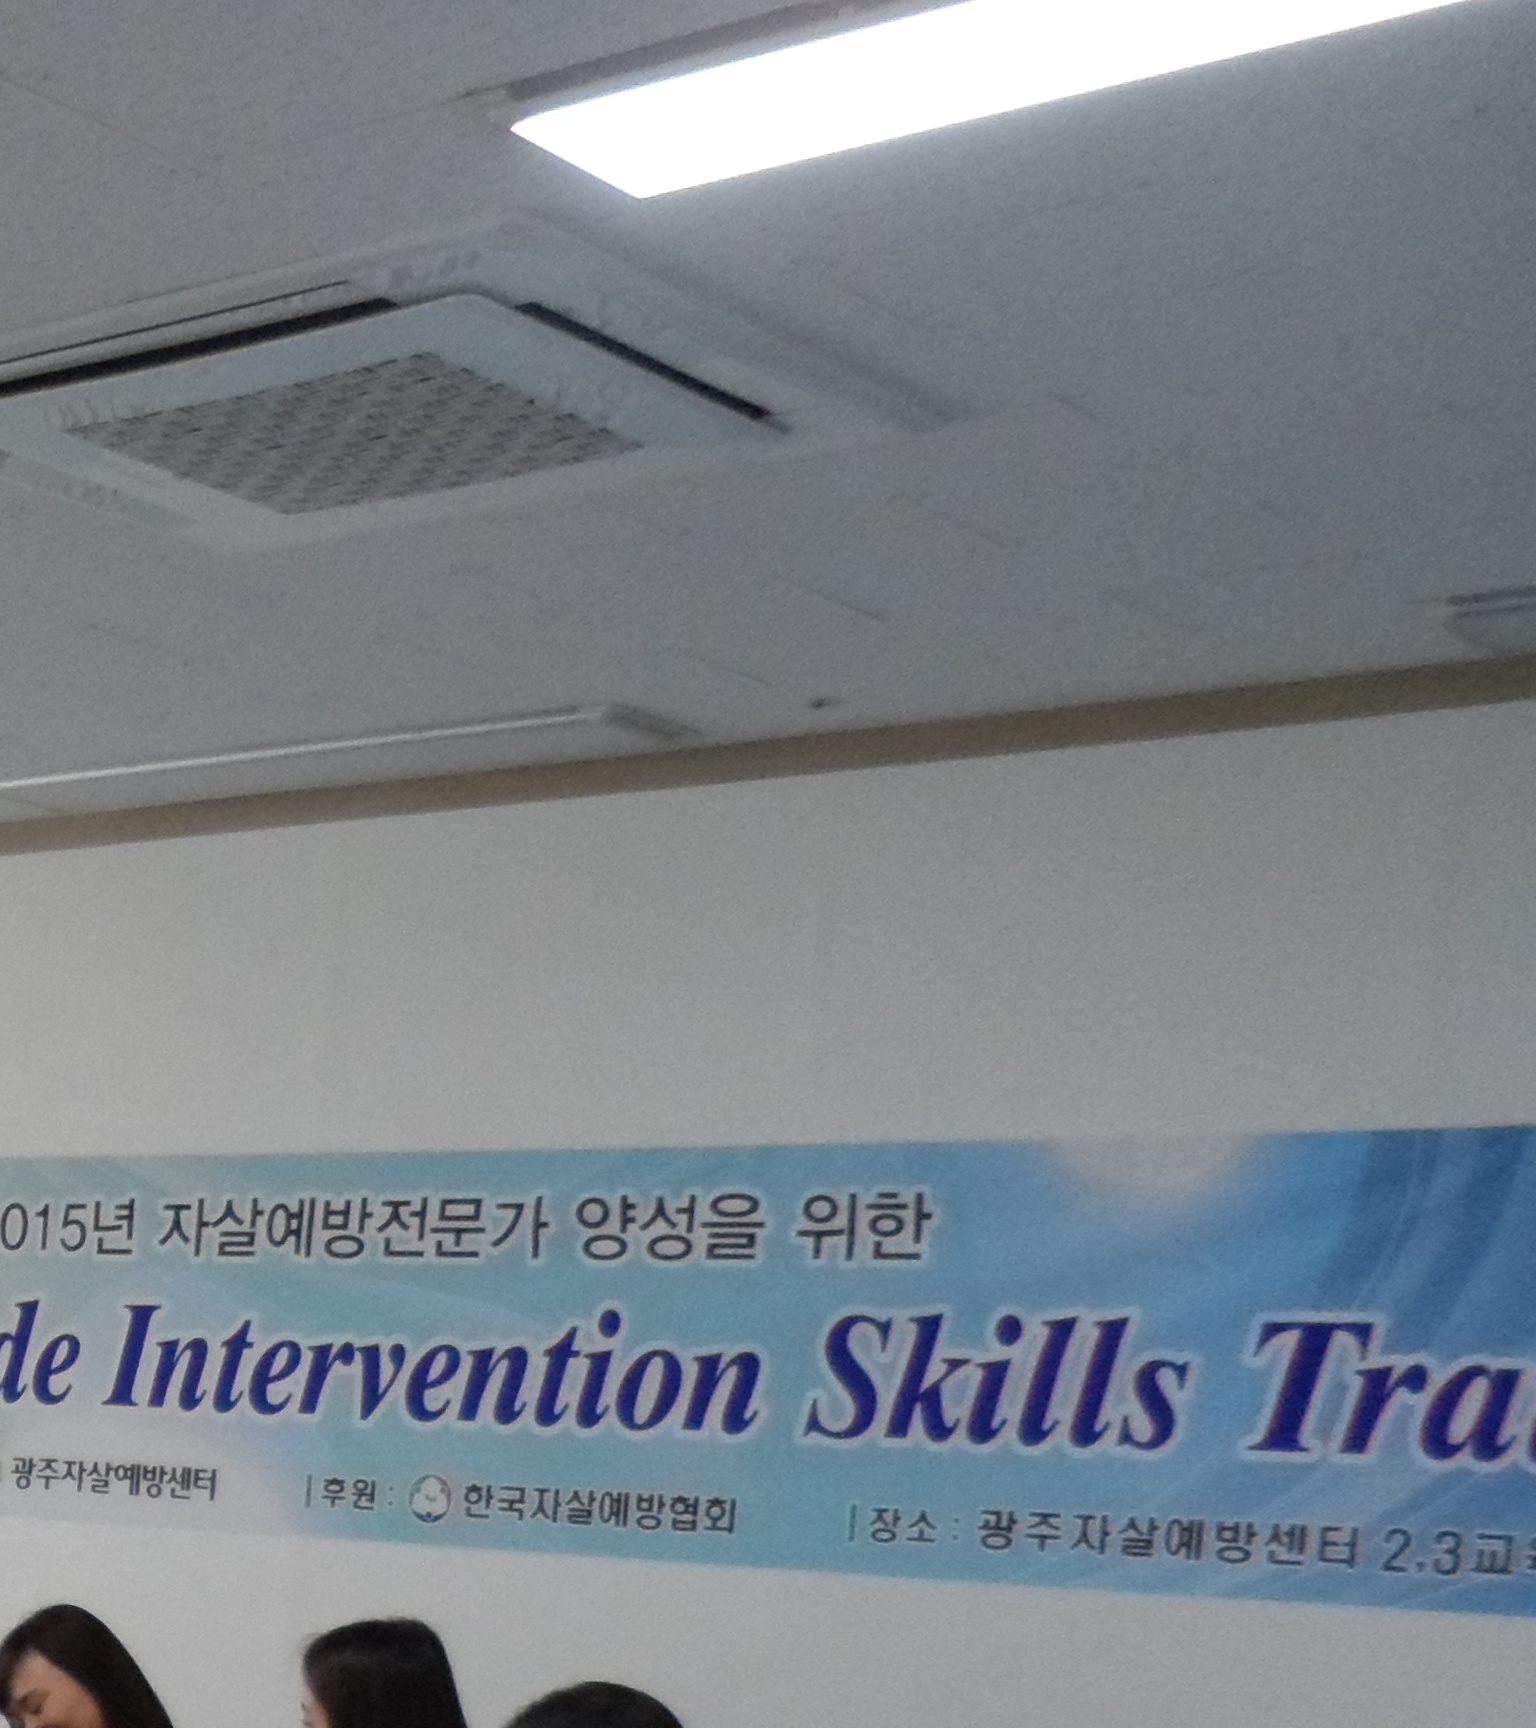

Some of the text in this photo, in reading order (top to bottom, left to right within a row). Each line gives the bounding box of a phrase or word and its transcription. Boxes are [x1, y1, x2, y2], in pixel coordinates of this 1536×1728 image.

[159, 1197, 549, 1259] 자살예방전문가
[575, 1192, 766, 1261] 양성을
[796, 1192, 933, 1261] 위한
[103, 1304, 761, 1436] Intervention
[804, 1313, 1191, 1451] Skills
[1248, 1321, 1536, 1462] Tra
[10, 1456, 218, 1500] 광주자살예방센터
[463, 1483, 737, 1534] 한국자살예방협회
[977, 1508, 1359, 1569] 광주자살예방센터
